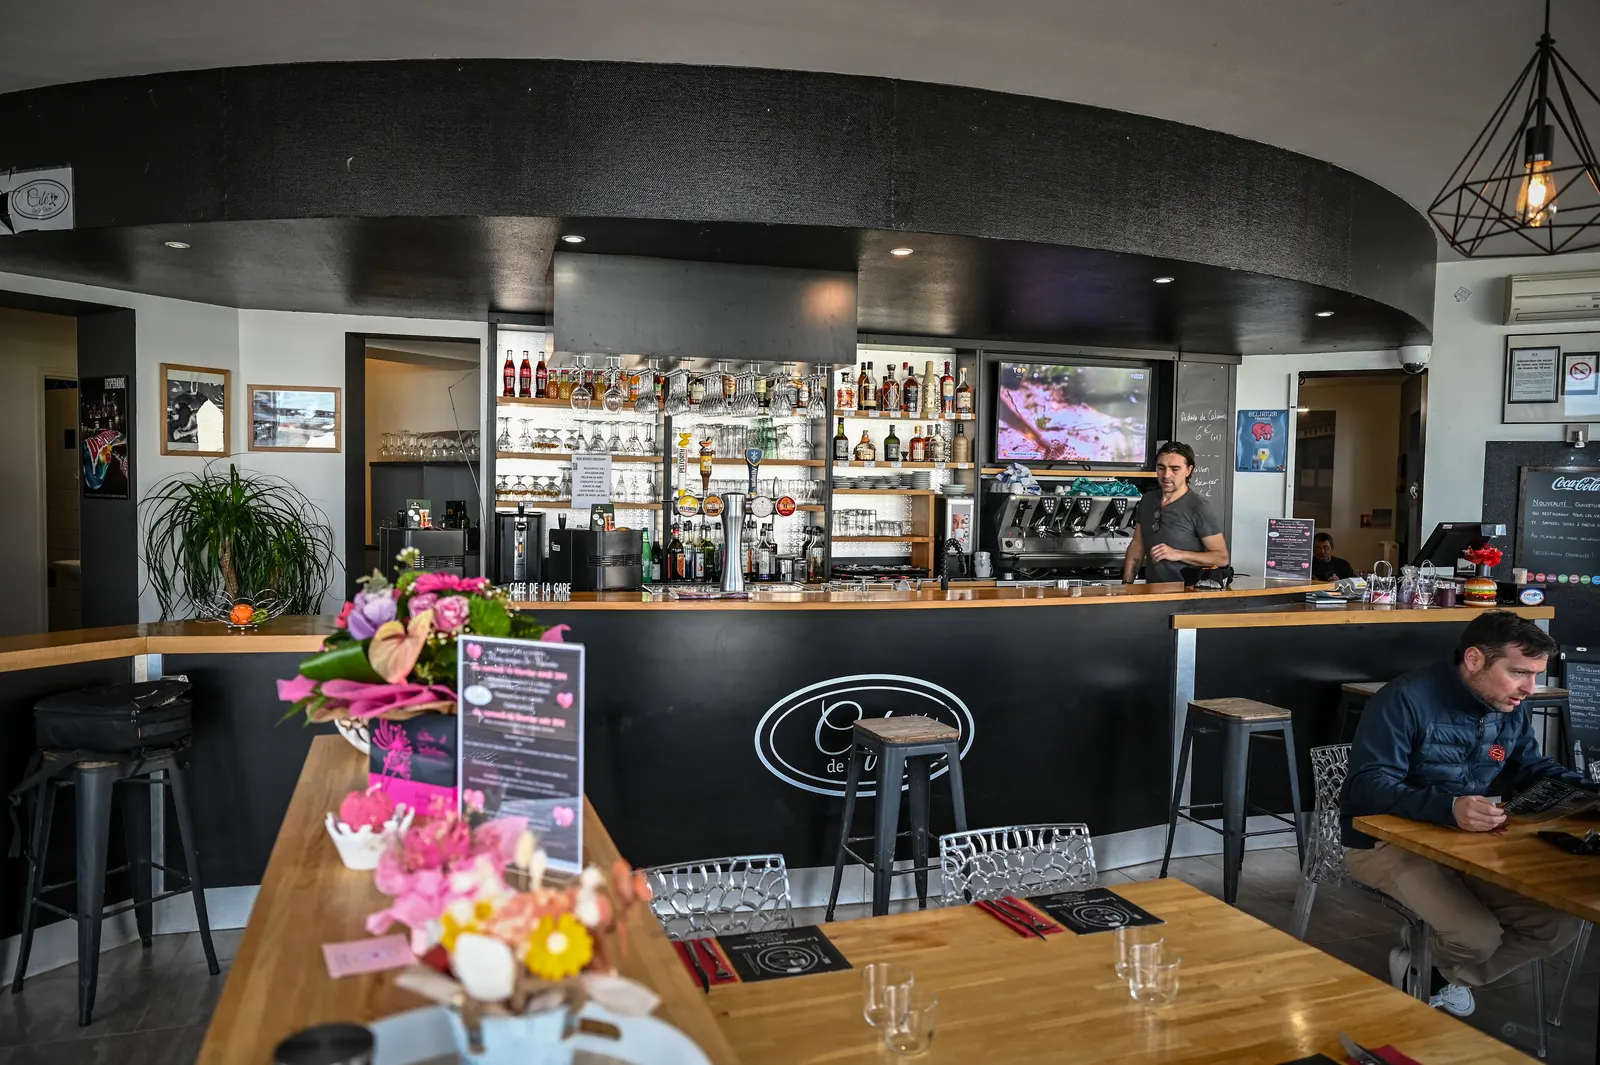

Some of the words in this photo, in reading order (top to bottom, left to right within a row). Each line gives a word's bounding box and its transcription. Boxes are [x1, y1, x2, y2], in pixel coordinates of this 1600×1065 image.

[1552, 476, 1600, 491] Coca-Cola
[509, 582, 526, 594] CAFÉ
[529, 582, 538, 594] DE
[542, 582, 551, 594] LA
[553, 582, 571, 594] GARE
[827, 758, 844, 773] de
